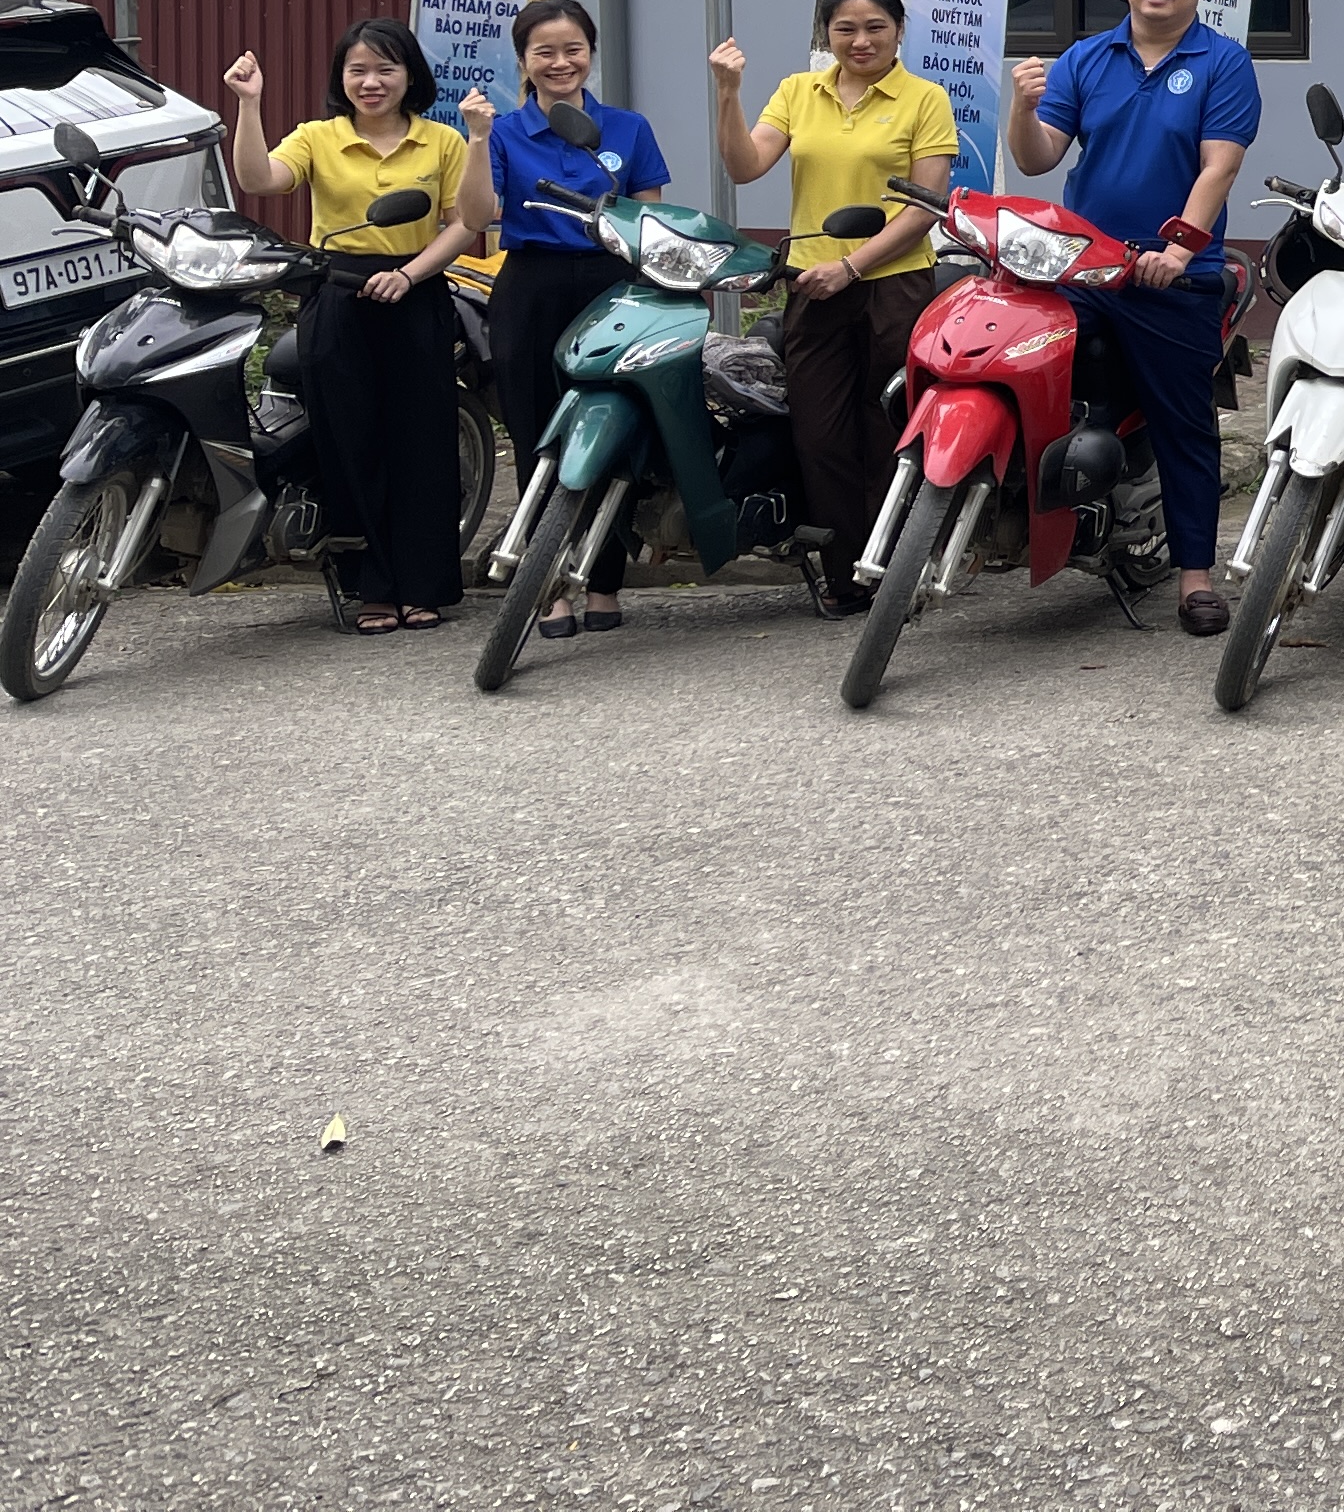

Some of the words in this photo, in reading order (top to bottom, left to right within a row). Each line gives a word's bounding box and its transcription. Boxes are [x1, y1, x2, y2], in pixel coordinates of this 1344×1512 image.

[495, 1, 520, 18] GIA
[931, 7, 962, 25] QUYẾT
[963, 10, 983, 28] TÂM
[1205, 9, 1212, 24] Y
[1212, 8, 1225, 27] TẾ
[435, 13, 462, 35] BẢO
[466, 16, 502, 39] HIỂM
[452, 42, 461, 58] Y
[463, 38, 482, 59] TẾ
[931, 29, 956, 48] THỰC
[958, 32, 981, 51] HIỆN
[434, 57, 450, 80] ĐỂ
[452, 65, 495, 88] ĐƯỢC
[922, 52, 950, 72] BẢO
[952, 55, 984, 76] HIỂM
[948, 80, 975, 101] HỘI,
[13, 248, 138, 296] 97A-031.7
